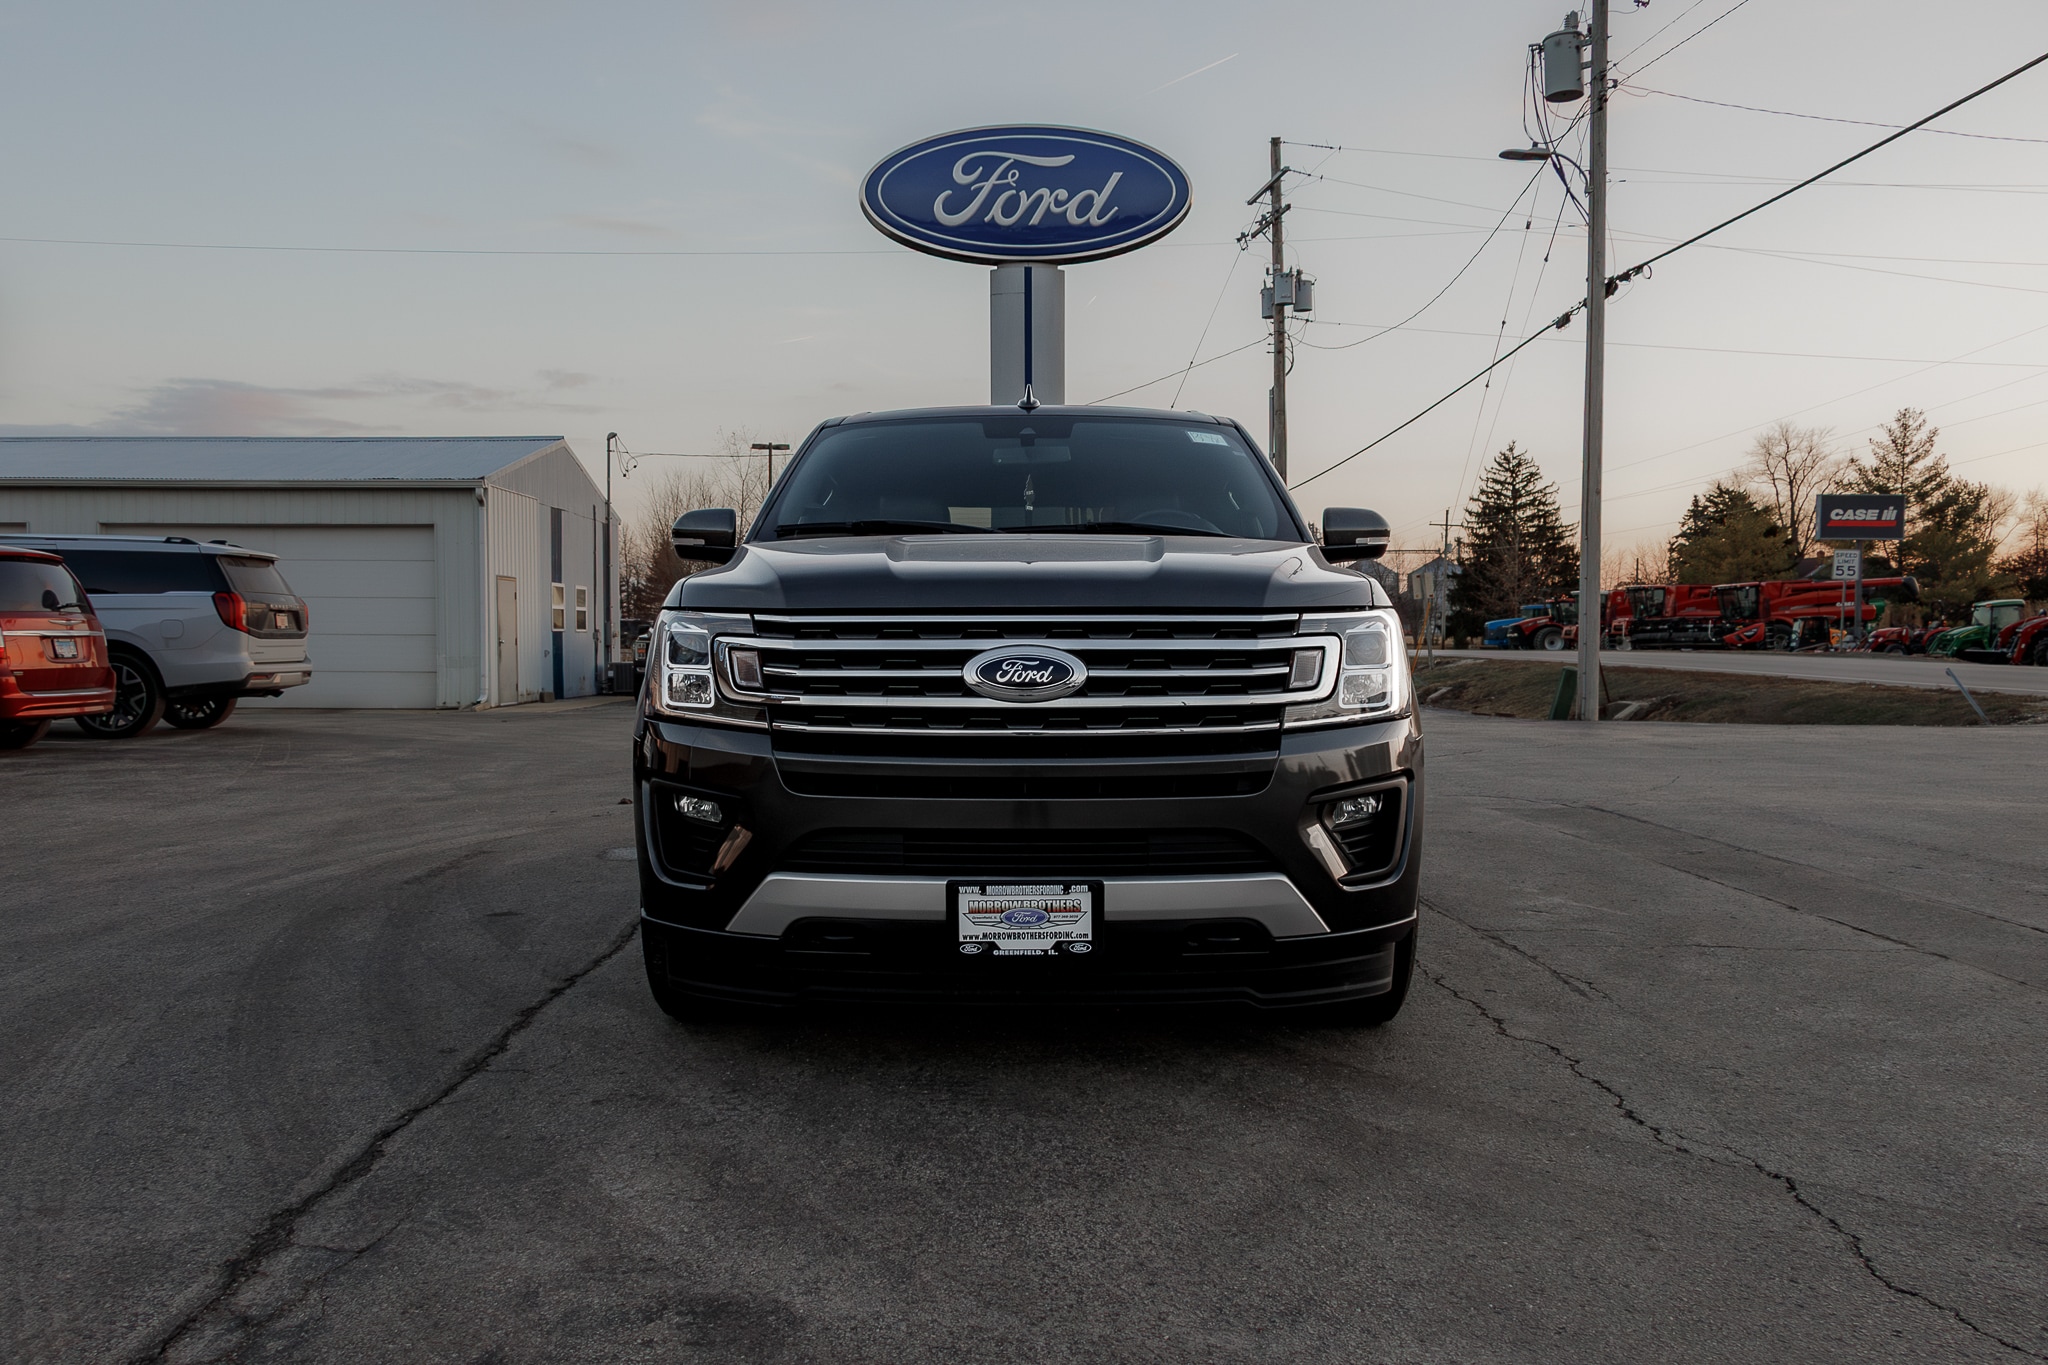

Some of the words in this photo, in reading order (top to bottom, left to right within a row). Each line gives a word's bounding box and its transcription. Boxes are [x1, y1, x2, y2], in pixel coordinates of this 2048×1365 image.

[933, 151, 1123, 226] Ford
[1830, 508, 1880, 520] CASE
[1835, 565, 1856, 576] 55
[995, 659, 1054, 683] Ford
[968, 900, 1021, 914] MORROW
[1011, 911, 1038, 923] Ford
